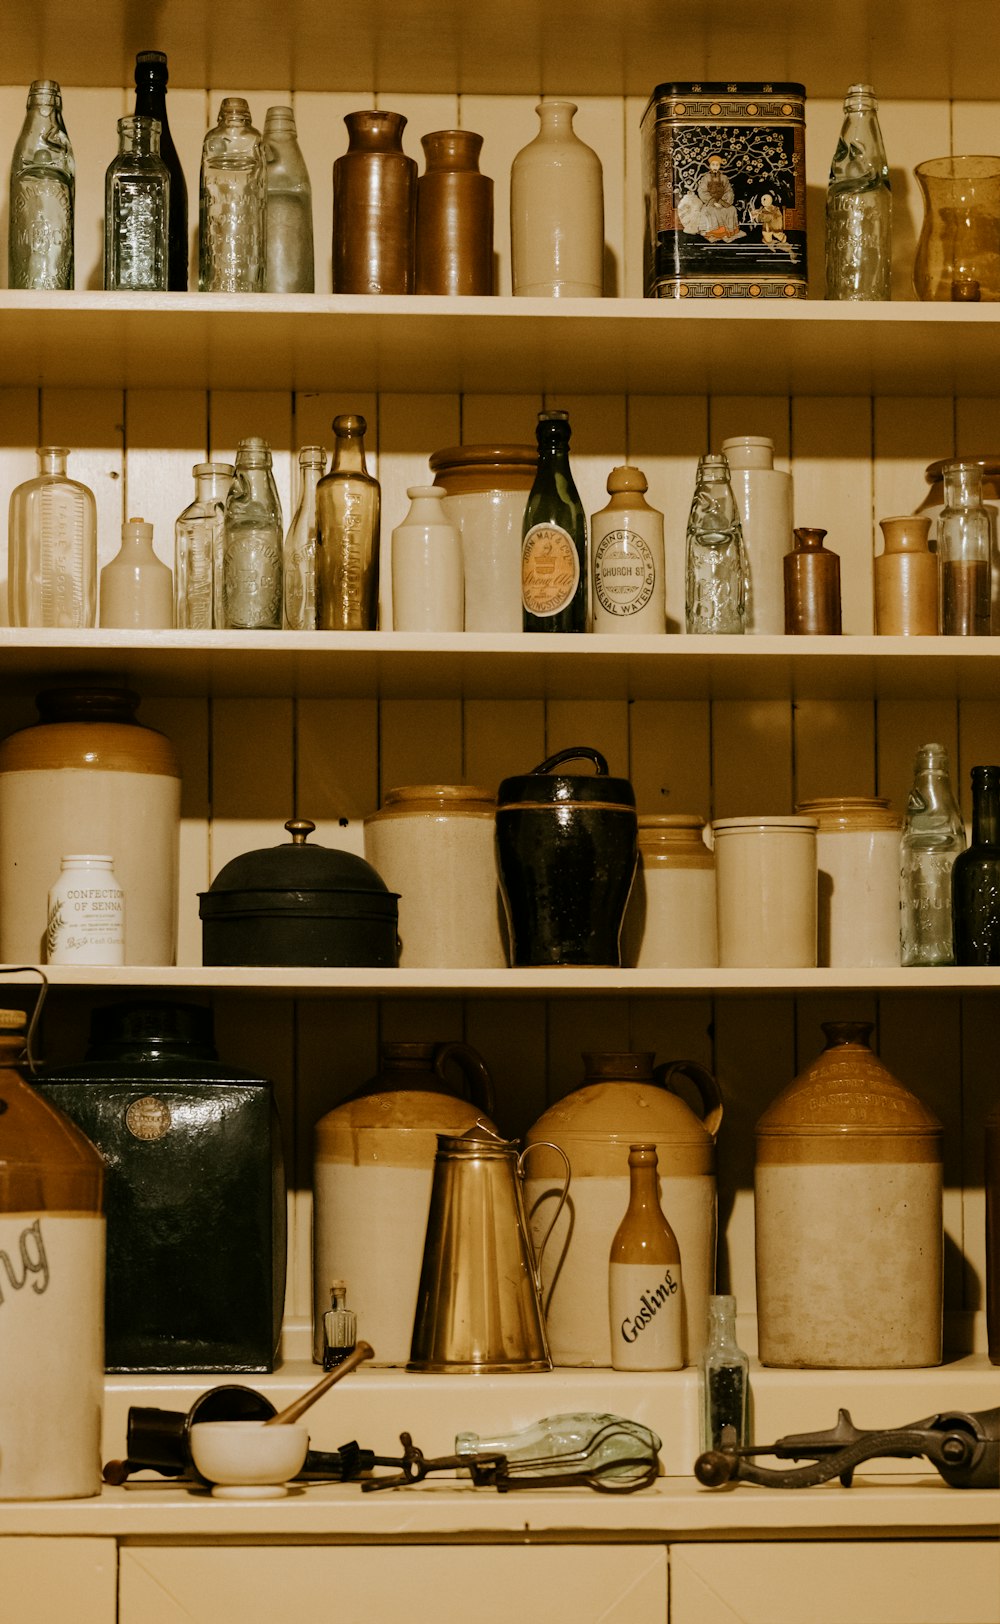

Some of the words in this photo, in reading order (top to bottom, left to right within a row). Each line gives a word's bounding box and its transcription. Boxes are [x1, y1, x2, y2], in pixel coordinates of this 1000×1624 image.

[524, 540, 536, 563] JOHN
[536, 531, 556, 540] MAY
[596, 532, 651, 560] BASINGSTOKE
[602, 566, 632, 577] CHURCH
[524, 588, 567, 611] BASINGSTOKE
[595, 573, 618, 613] MINERAL
[621, 588, 651, 613] WATER
[74, 902, 88, 911] OF
[92, 902, 122, 911] SENNA
[621, 1269, 678, 1343] Gosling
